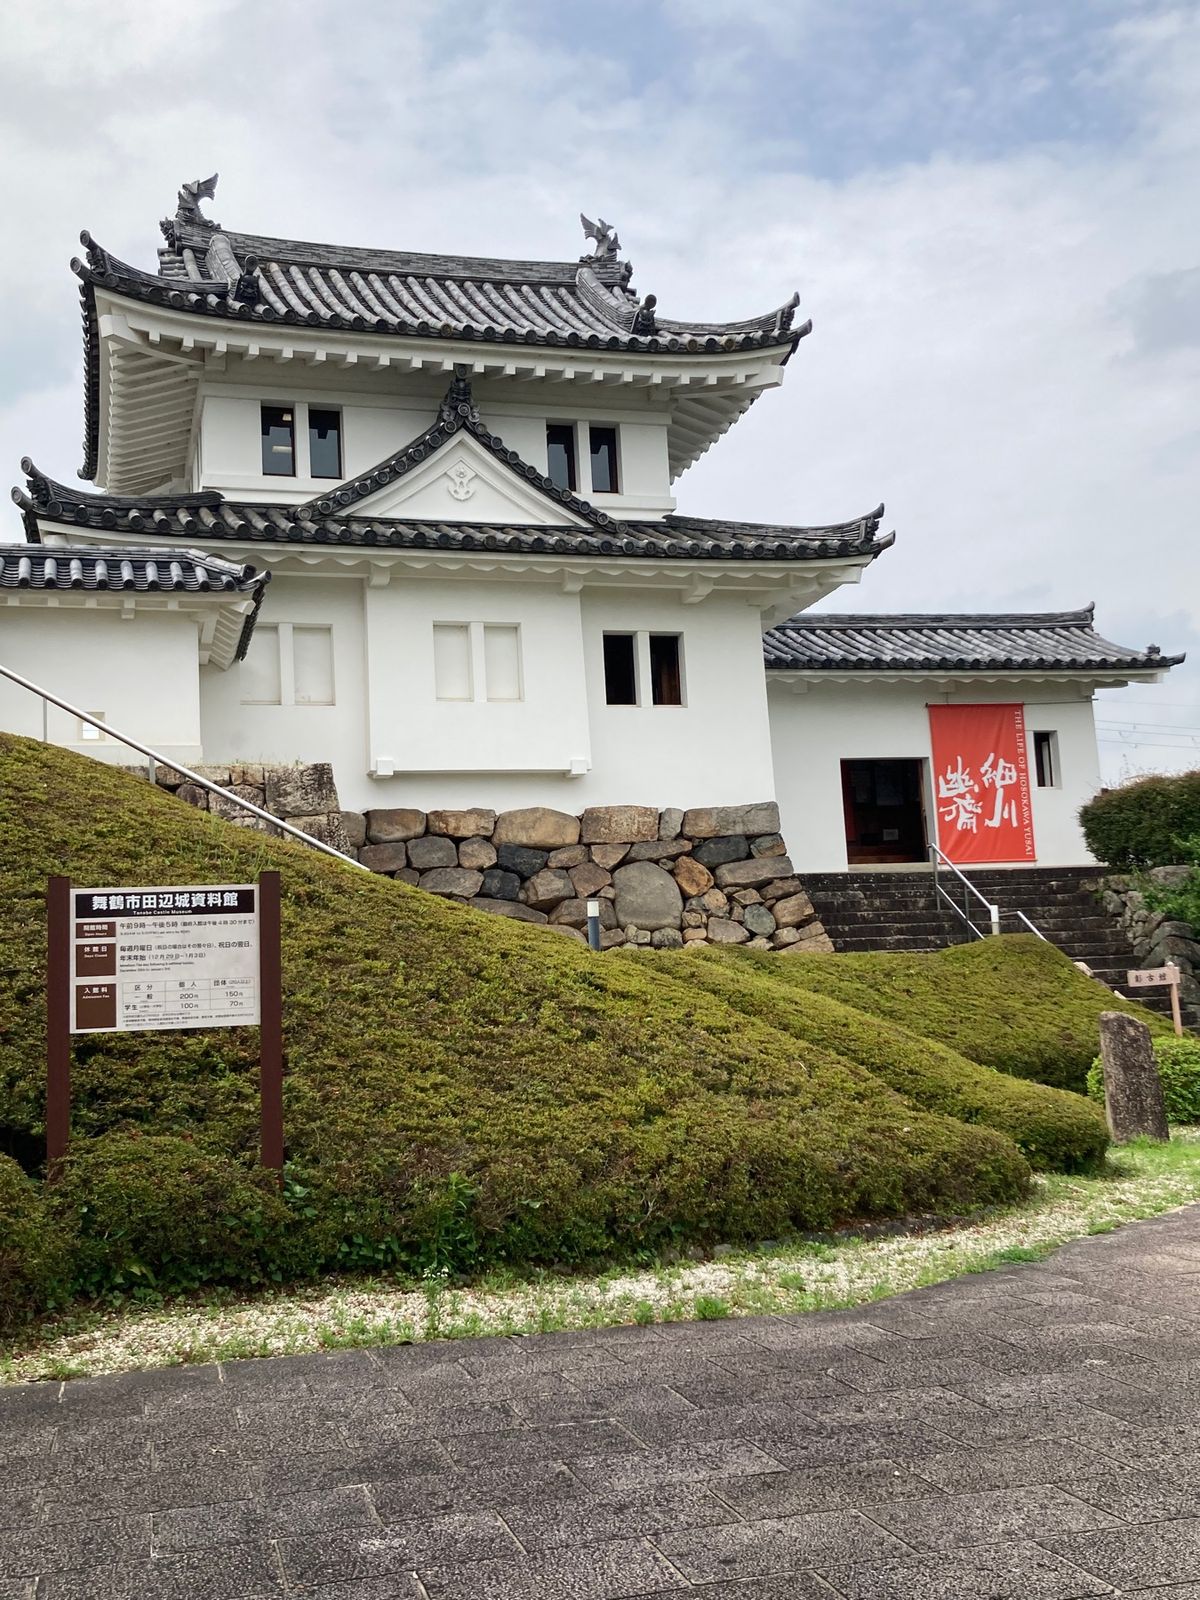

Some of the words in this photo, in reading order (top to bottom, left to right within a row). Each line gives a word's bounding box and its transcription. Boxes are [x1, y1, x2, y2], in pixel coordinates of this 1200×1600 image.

[1014, 711, 1022, 730] THE
[1015, 733, 1024, 754] LIFE
[1018, 757, 1026, 770] OF
[980, 752, 1018, 828] 細川
[1018, 773, 1031, 825] HOSOKAWA
[1023, 827, 1032, 857] YUSAI
[92, 892, 239, 911] 舞鶴市田辺城資料館
